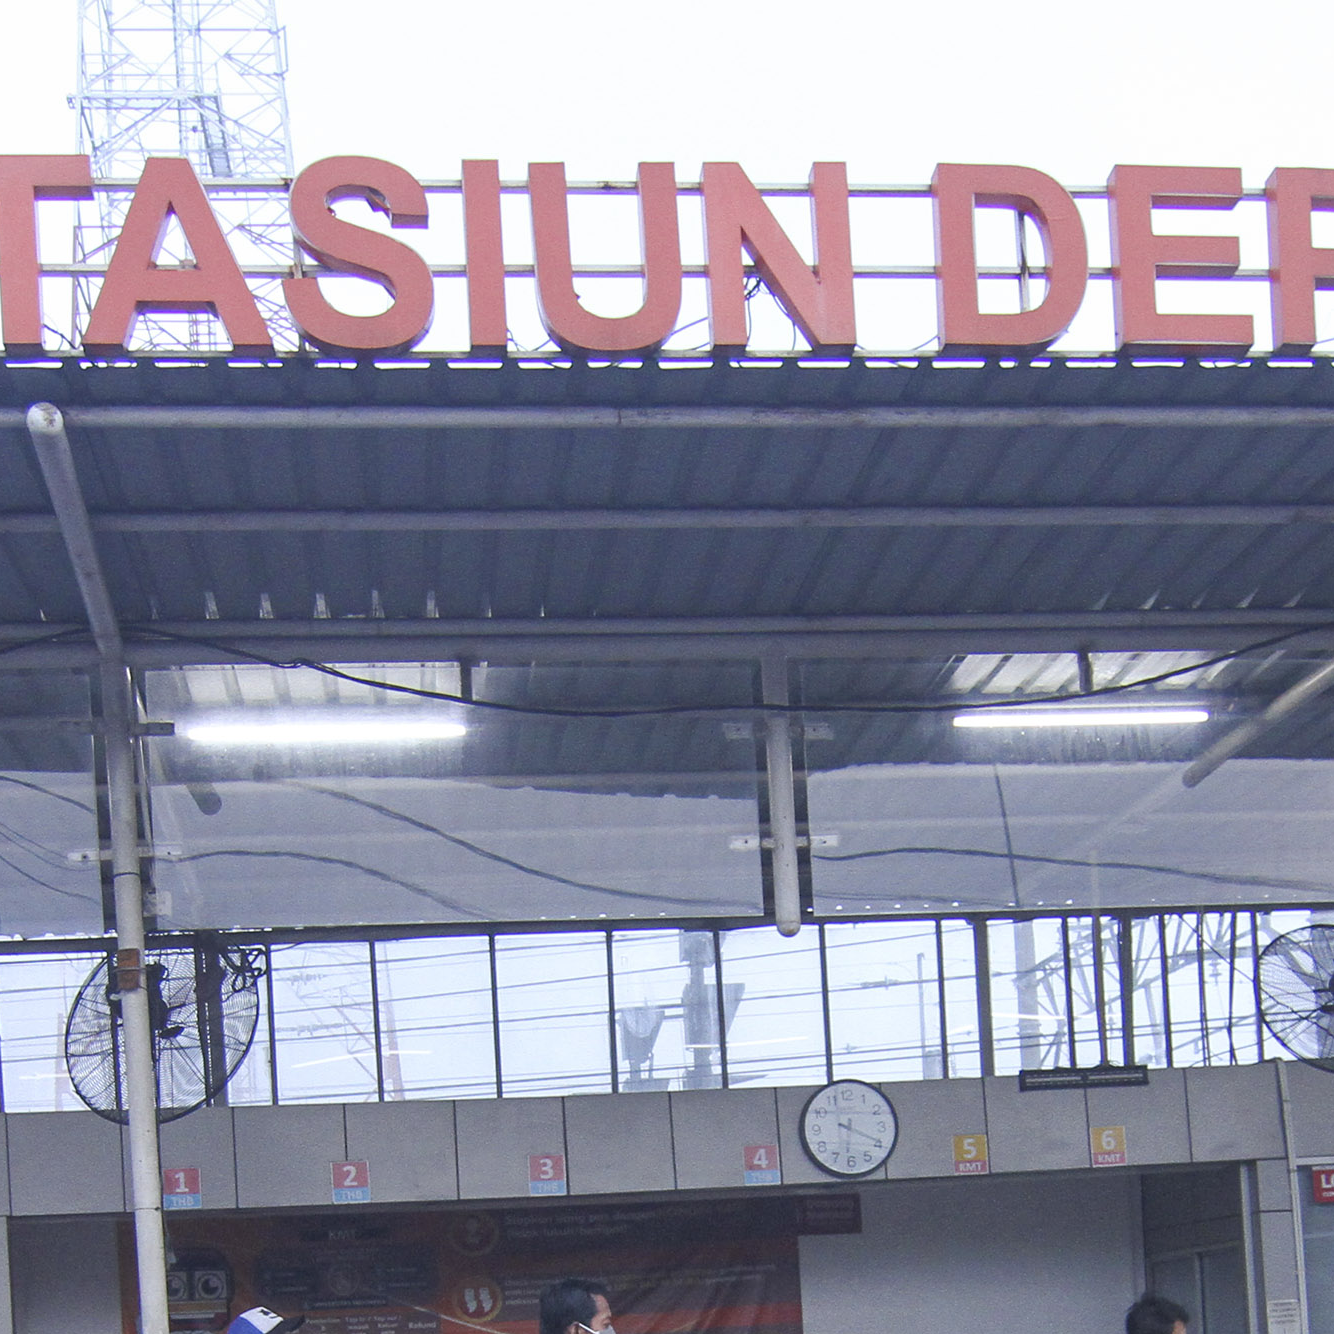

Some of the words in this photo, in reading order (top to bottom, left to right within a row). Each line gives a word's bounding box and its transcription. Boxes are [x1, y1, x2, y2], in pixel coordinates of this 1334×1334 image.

[841, 1089, 853, 1101] 12
[872, 1104, 881, 1116] 2
[812, 1124, 821, 1136] 9
[877, 1121, 886, 1133] 3
[1101, 1129, 1115, 1151] 6
[818, 1141, 827, 1153] 8
[963, 1137, 977, 1159] 5
[753, 1148, 768, 1169] 4
[832, 1152, 840, 1163] 7
[847, 1156, 857, 1168] 6
[864, 1152, 872, 1162] 5
[1098, 1153, 1120, 1163] KMT
[539, 1158, 554, 1179] 3
[959, 1162, 982, 1172] KMT
[342, 1165, 358, 1186] 2
[175, 1171, 189, 1193] 1
